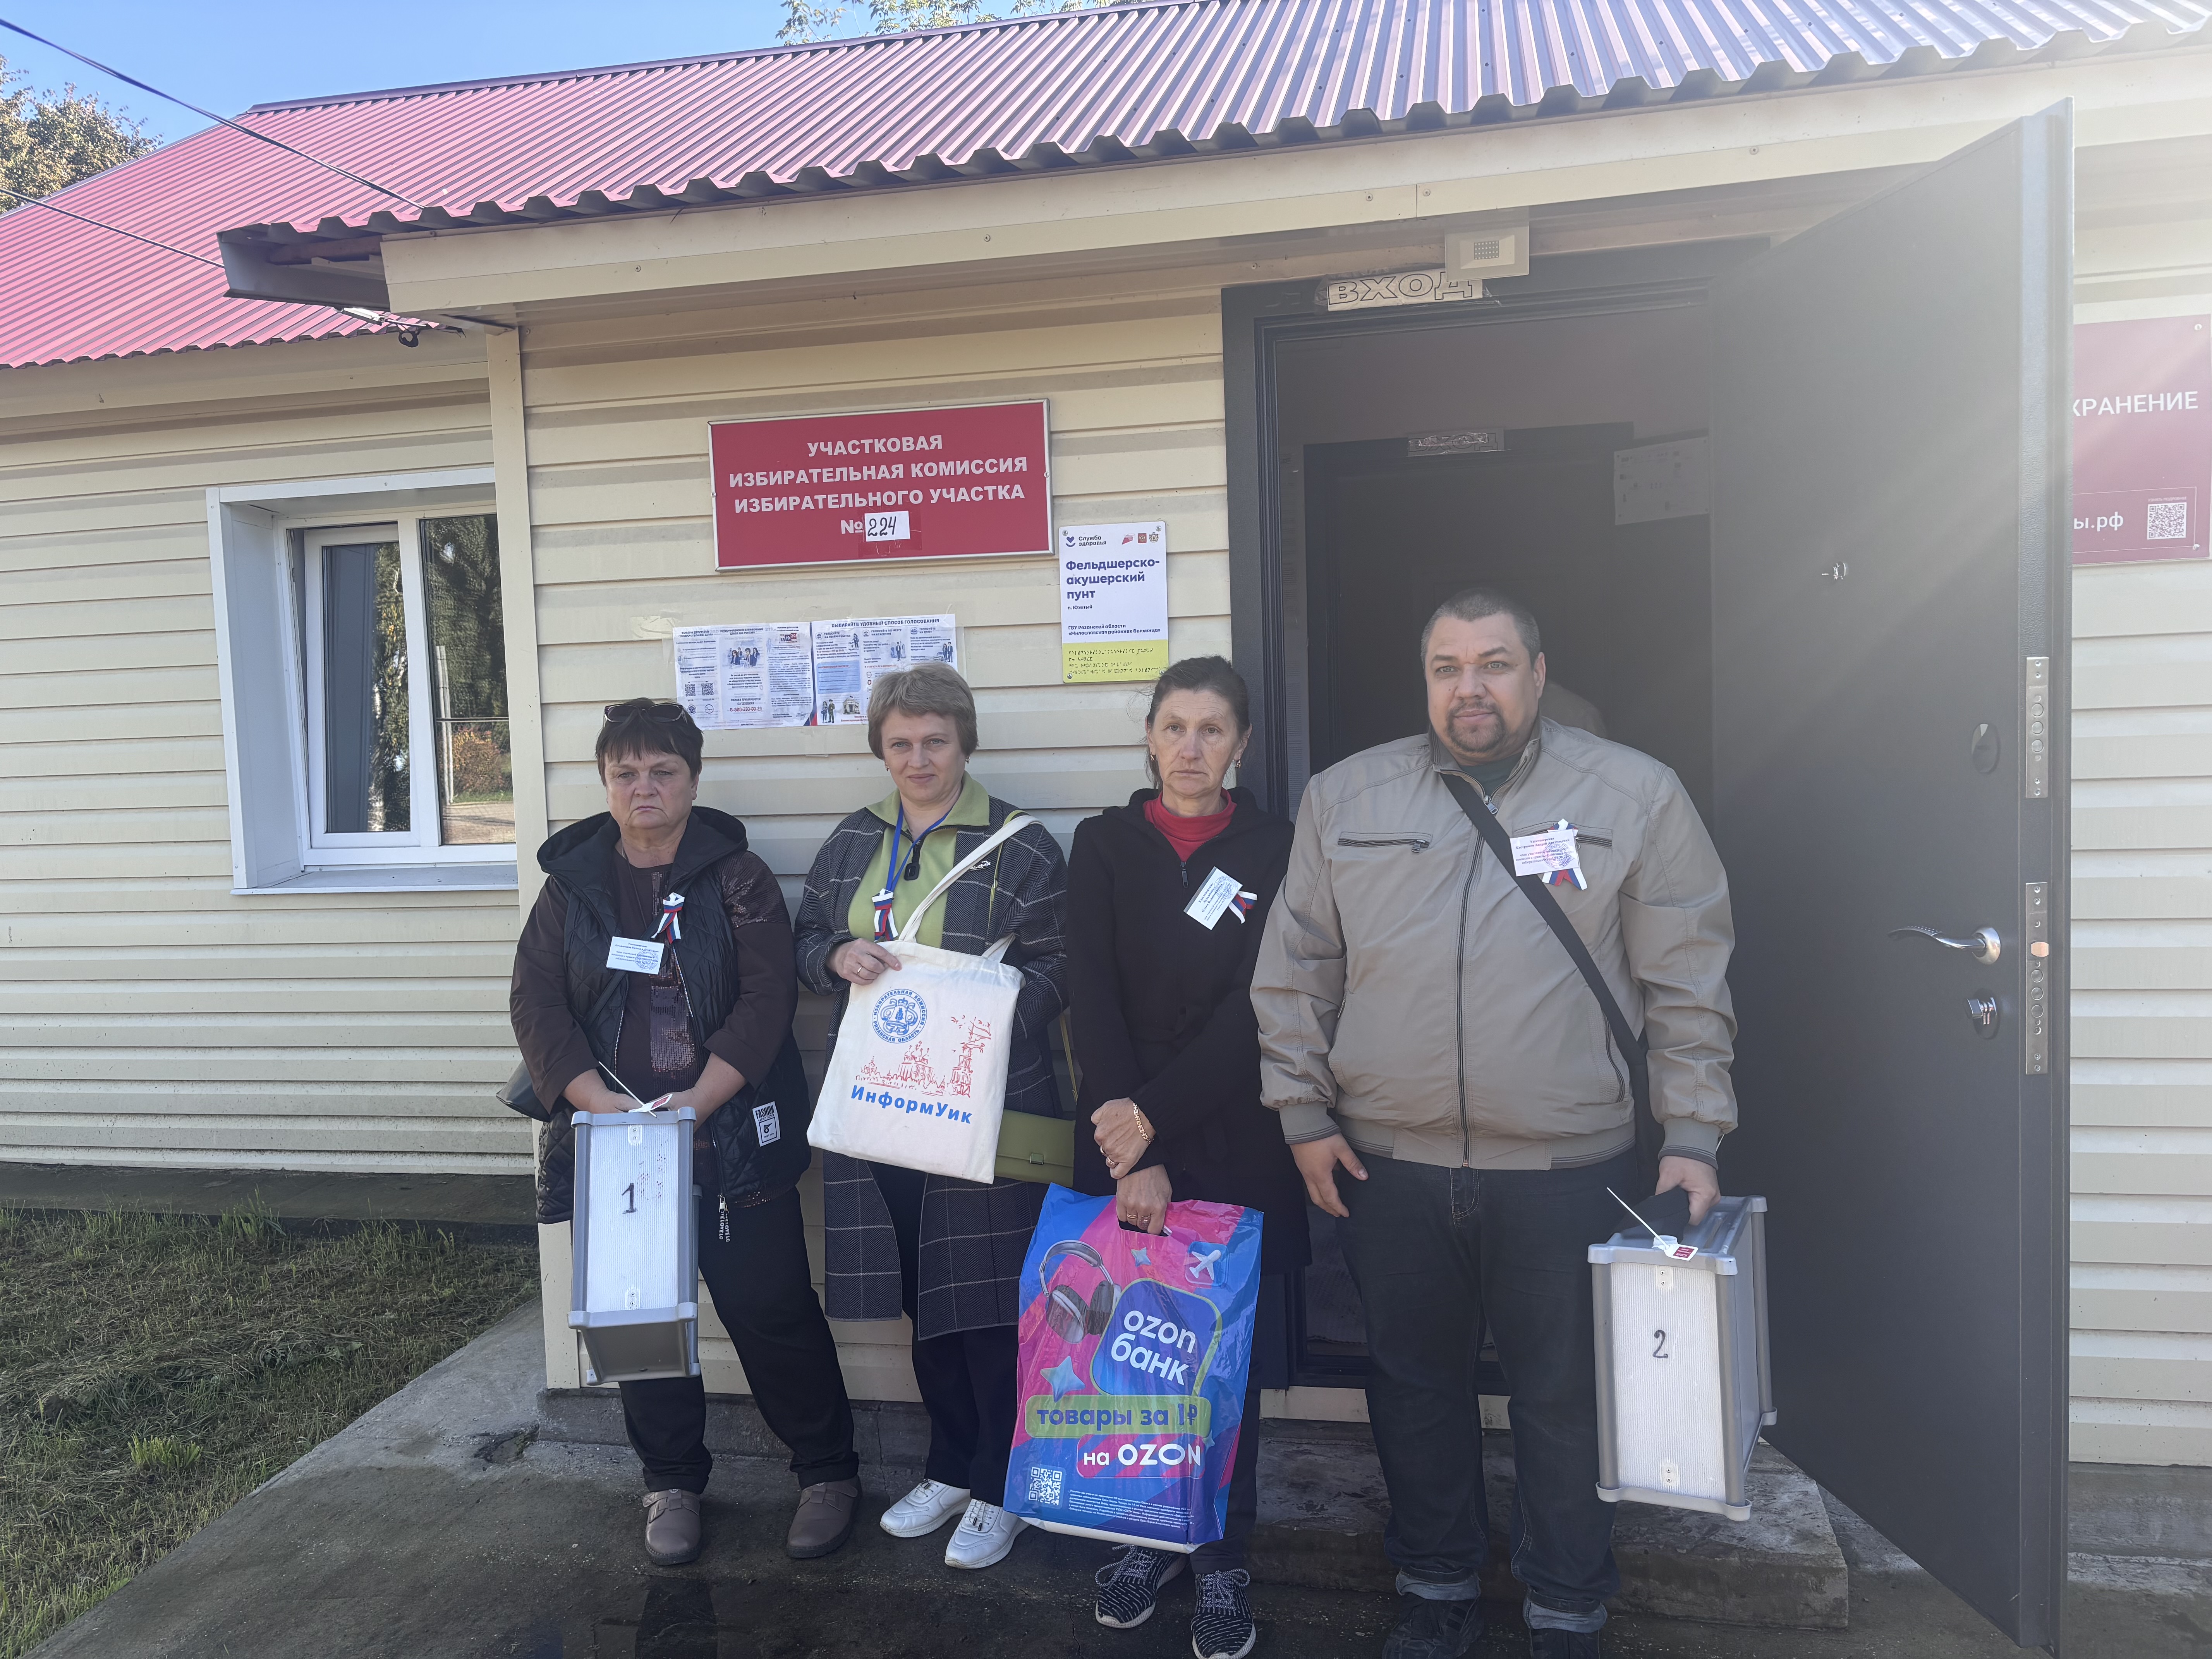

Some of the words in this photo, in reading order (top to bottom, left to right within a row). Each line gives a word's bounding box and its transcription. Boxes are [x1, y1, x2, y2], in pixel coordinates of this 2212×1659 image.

[807, 435, 943, 457] УЧАСТКОВАЯ
[730, 465, 903, 488] ИЗБИРАТЕЛЬНАЯ
[911, 457, 1027, 478] КОМИССИЯ
[735, 489, 923, 514] ИЗБИРАТЕЛЬНОГО
[930, 484, 1025, 503] УЧАСТКА
[1066, 559, 1160, 571] Фельдшерско-
[1066, 571, 1145, 586] акушерский
[1067, 590, 1096, 601] пунт
[874, 990, 912, 1015] ИЗБИРАТЕЛЬНАЯ
[914, 995, 926, 1025] КОМИССИЯ
[873, 1021, 895, 1042] РЯЗАНСКАЯ
[898, 1029, 919, 1042] ОБЛАСТЬ
[755, 1105, 775, 1119] FASHION
[851, 1085, 972, 1124] ИнформУик
[621, 1183, 637, 1214] 1
[1123, 1310, 1196, 1354] ozon
[1652, 1329, 1668, 1359] 2
[1111, 1333, 1189, 1386] банк
[1036, 1408, 1132, 1431] товары
[1140, 1408, 1168, 1426] за
[1083, 1451, 1109, 1467] на
[1118, 1443, 1201, 1467] OZON
